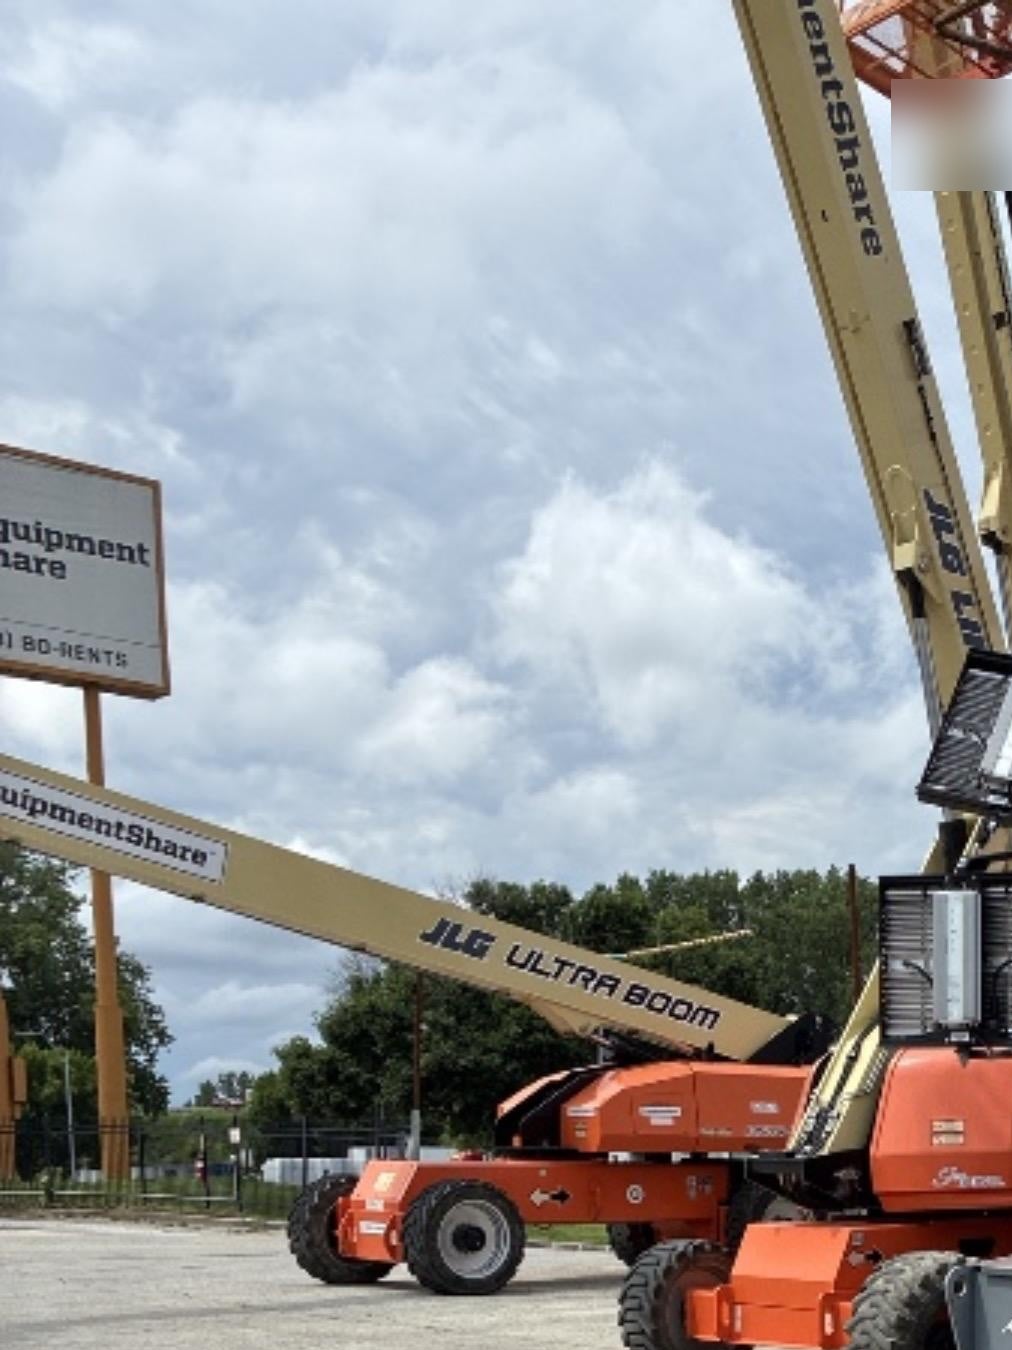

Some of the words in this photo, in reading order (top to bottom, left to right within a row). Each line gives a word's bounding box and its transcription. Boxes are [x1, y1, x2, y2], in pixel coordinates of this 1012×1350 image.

[799, 0, 883, 257] entShare
[923, 488, 967, 577] JLG
[420, 917, 497, 960] JLG
[505, 944, 621, 999] ULTRA
[623, 983, 721, 1030] BOOM
